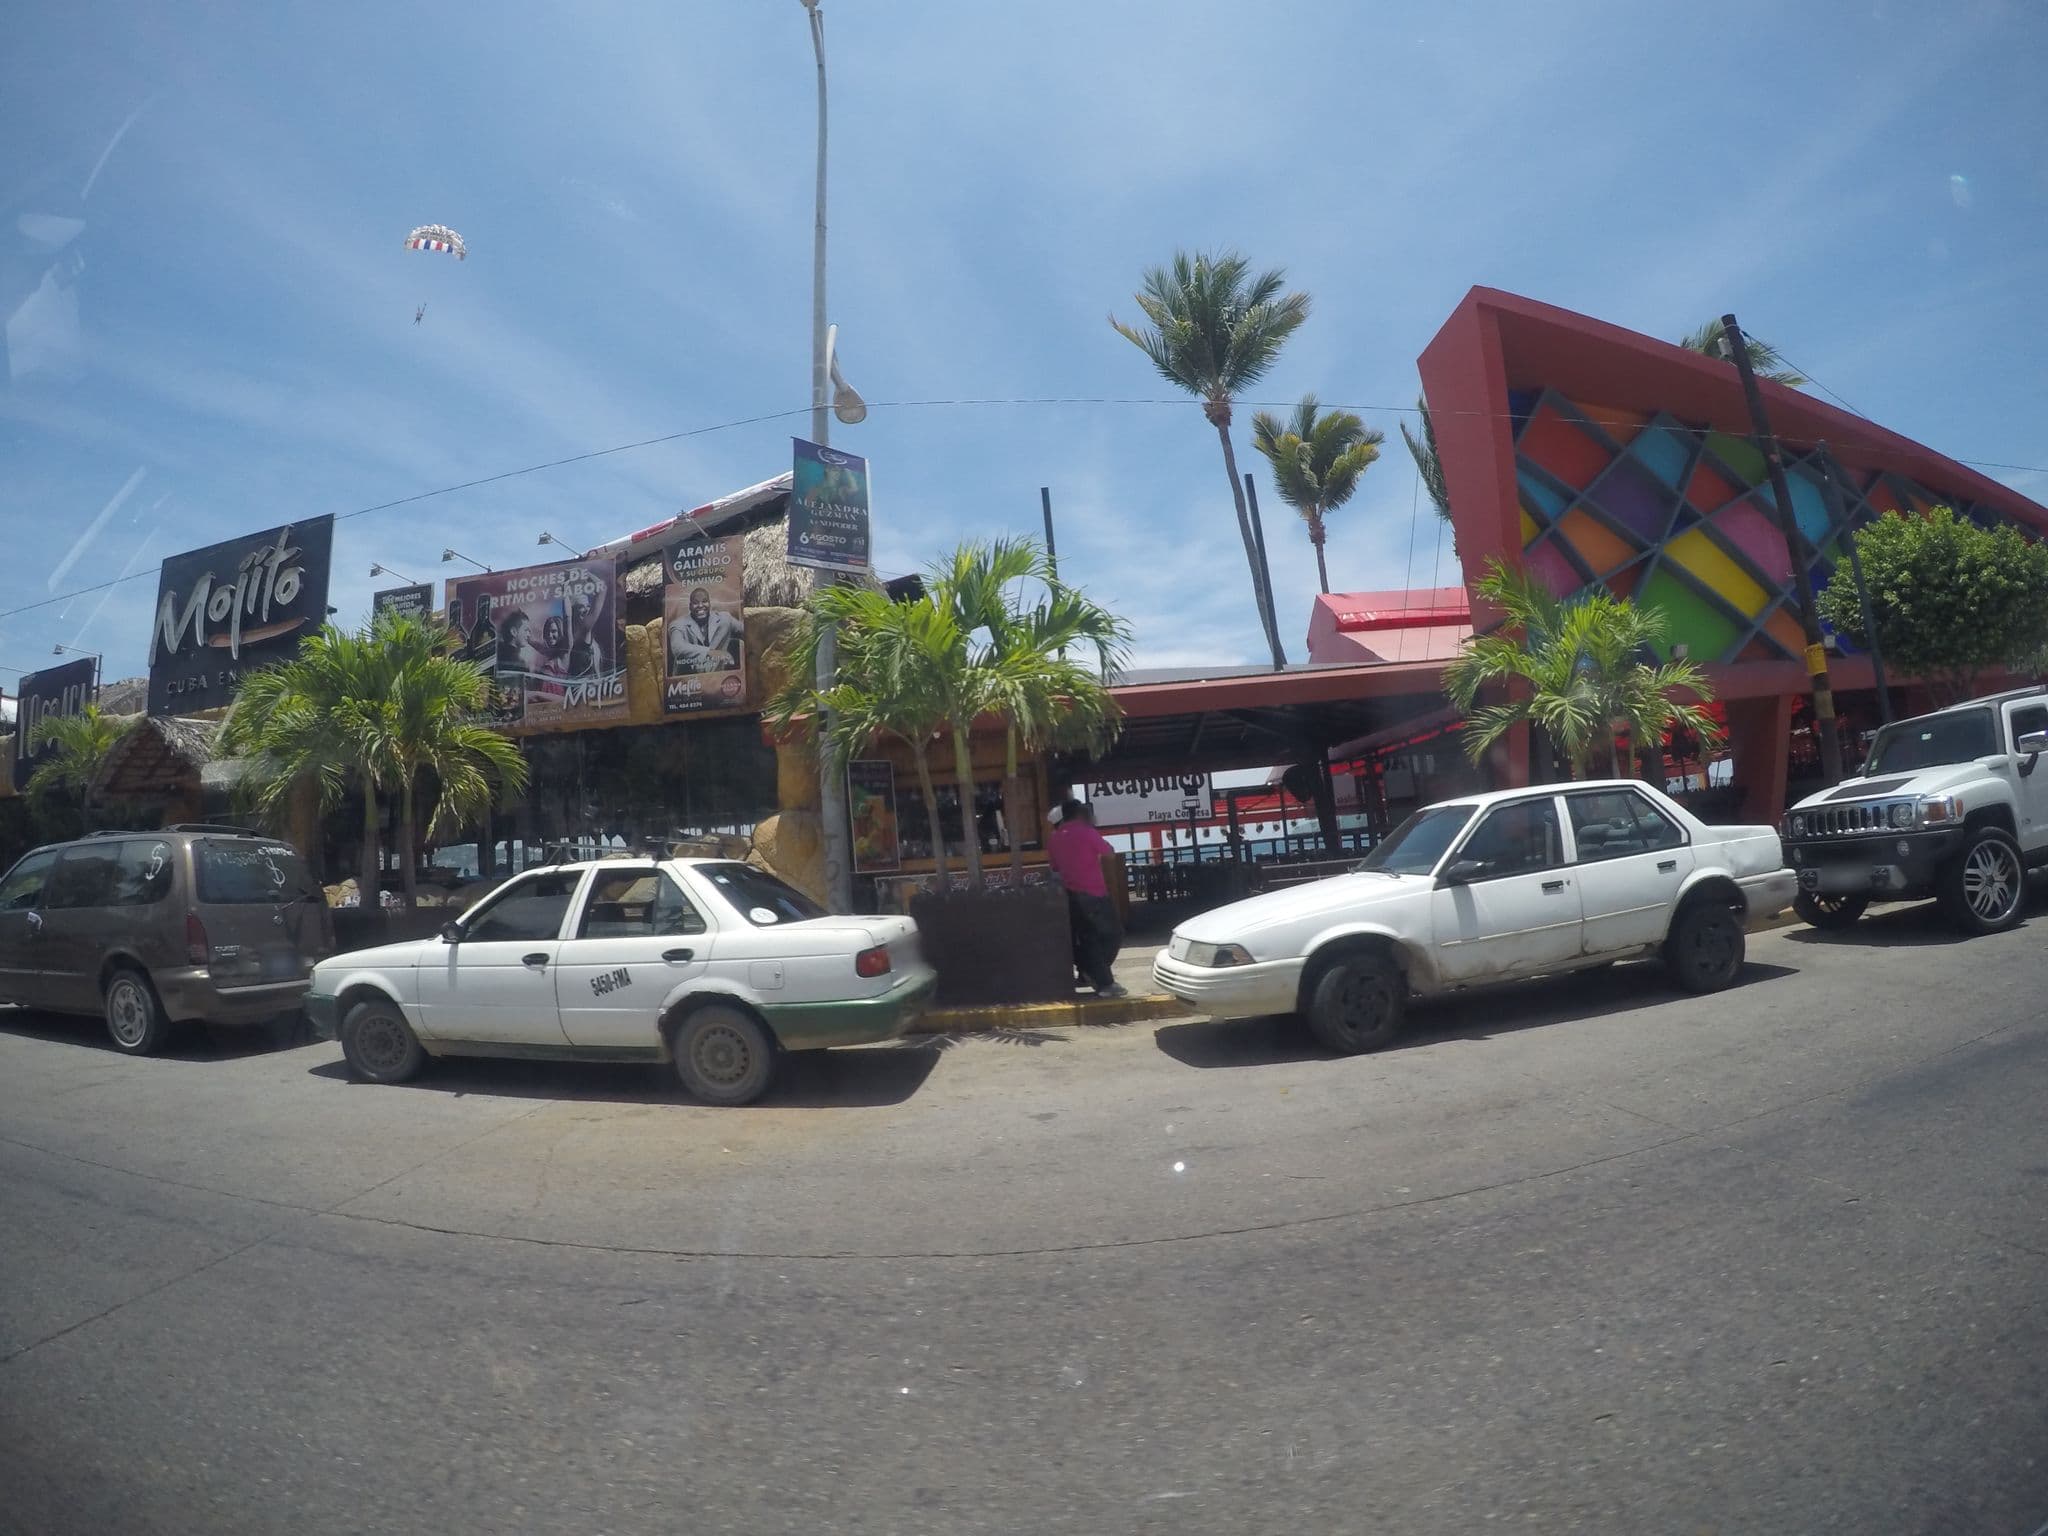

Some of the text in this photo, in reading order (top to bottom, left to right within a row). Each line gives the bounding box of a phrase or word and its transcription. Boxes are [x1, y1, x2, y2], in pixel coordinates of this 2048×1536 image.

[796, 497, 868, 517] ALEJANDRA
[800, 531, 809, 545] 6
[809, 533, 847, 545] AGOSTO
[677, 542, 727, 559] ARAMIS
[673, 555, 732, 572] GALINDO
[687, 569, 696, 577] SU
[698, 566, 726, 576] GRUPO
[507, 568, 589, 593] NOCHES DE
[681, 575, 723, 588] EN VIVO
[149, 524, 305, 668] Mojito
[491, 580, 607, 610] RITMO Y SABOR
[166, 675, 208, 695] CUBA
[563, 676, 624, 710] Mojito
[1148, 810, 1172, 821] Playa
